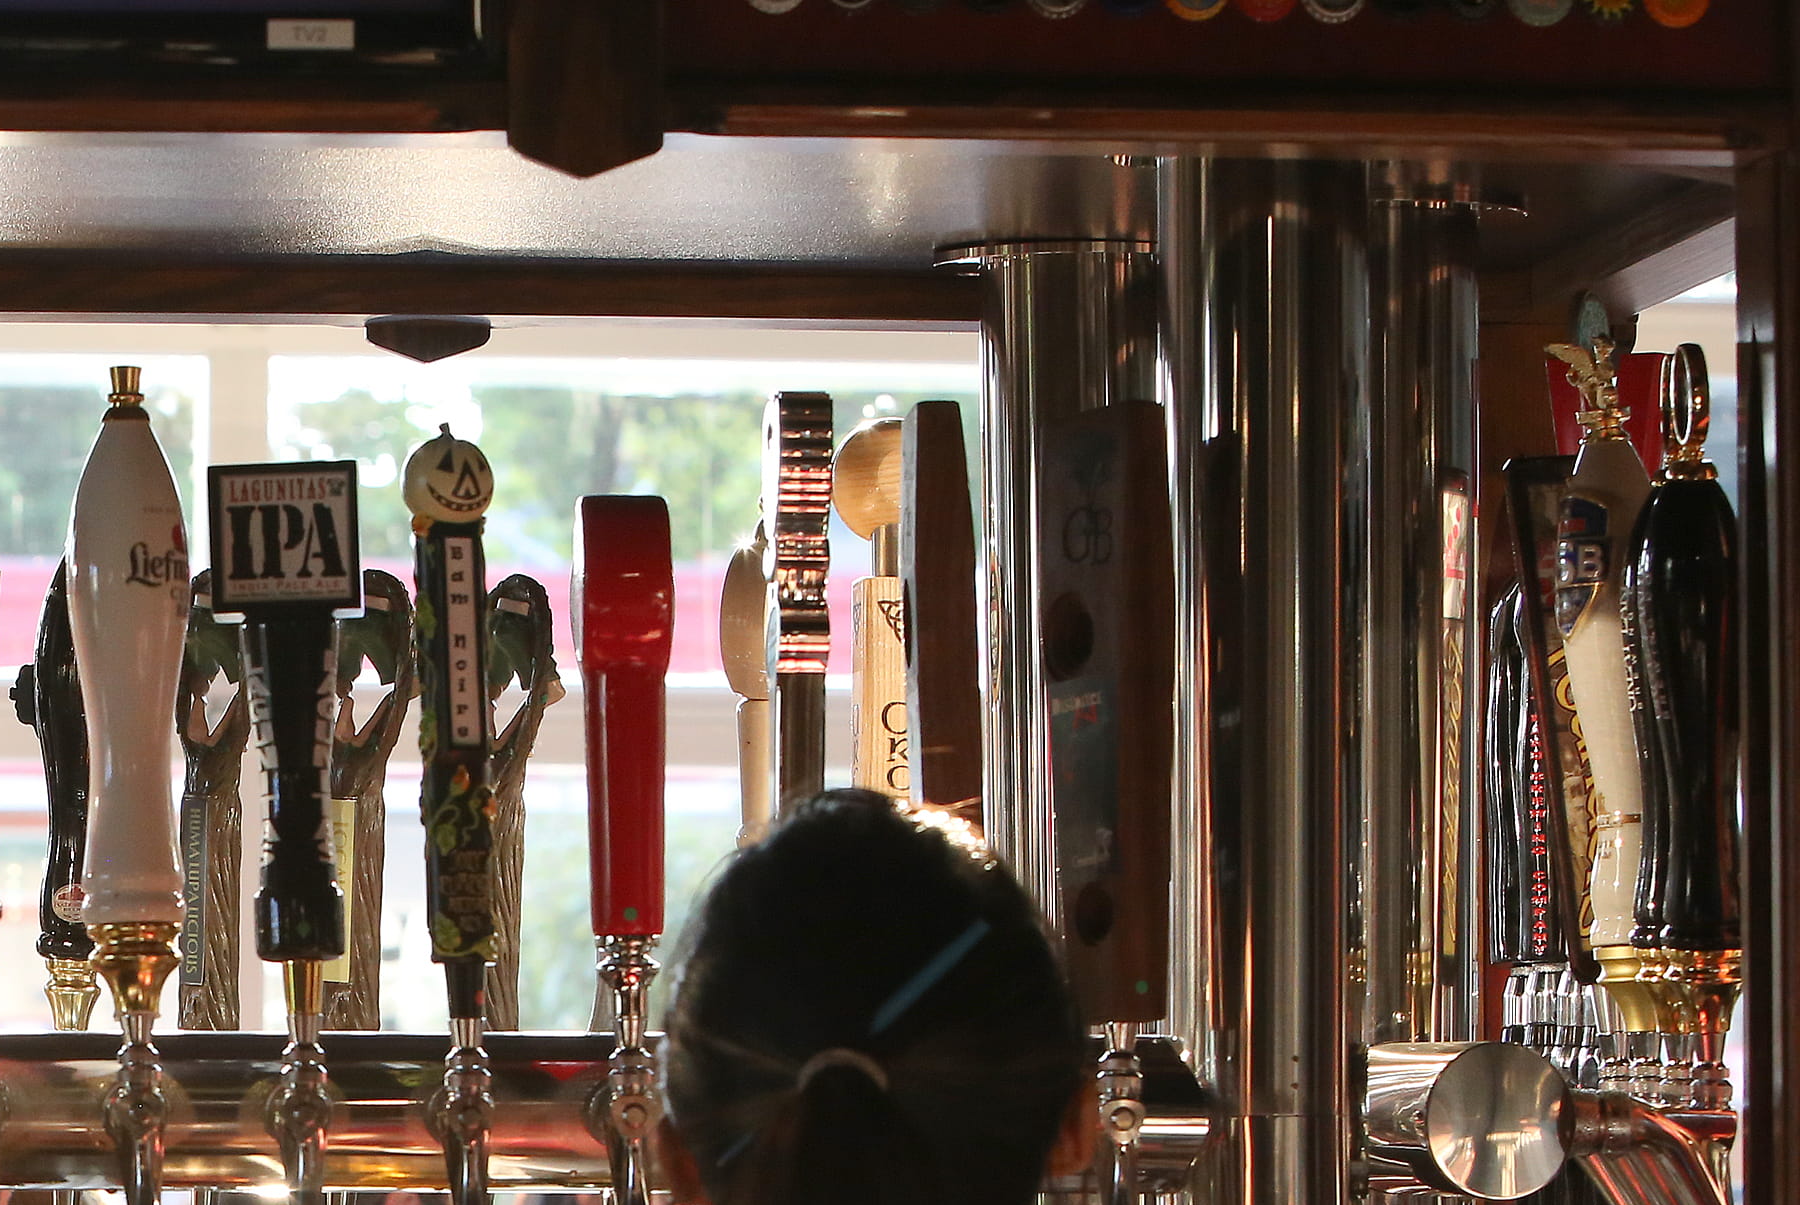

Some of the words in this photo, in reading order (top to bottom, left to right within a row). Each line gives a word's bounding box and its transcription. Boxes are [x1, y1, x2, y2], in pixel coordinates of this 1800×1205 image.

[229, 477, 327, 503] LAGUNITAS
[226, 502, 347, 581] IPA
[276, 580, 307, 590] PALE
[316, 579, 341, 589] ALE
